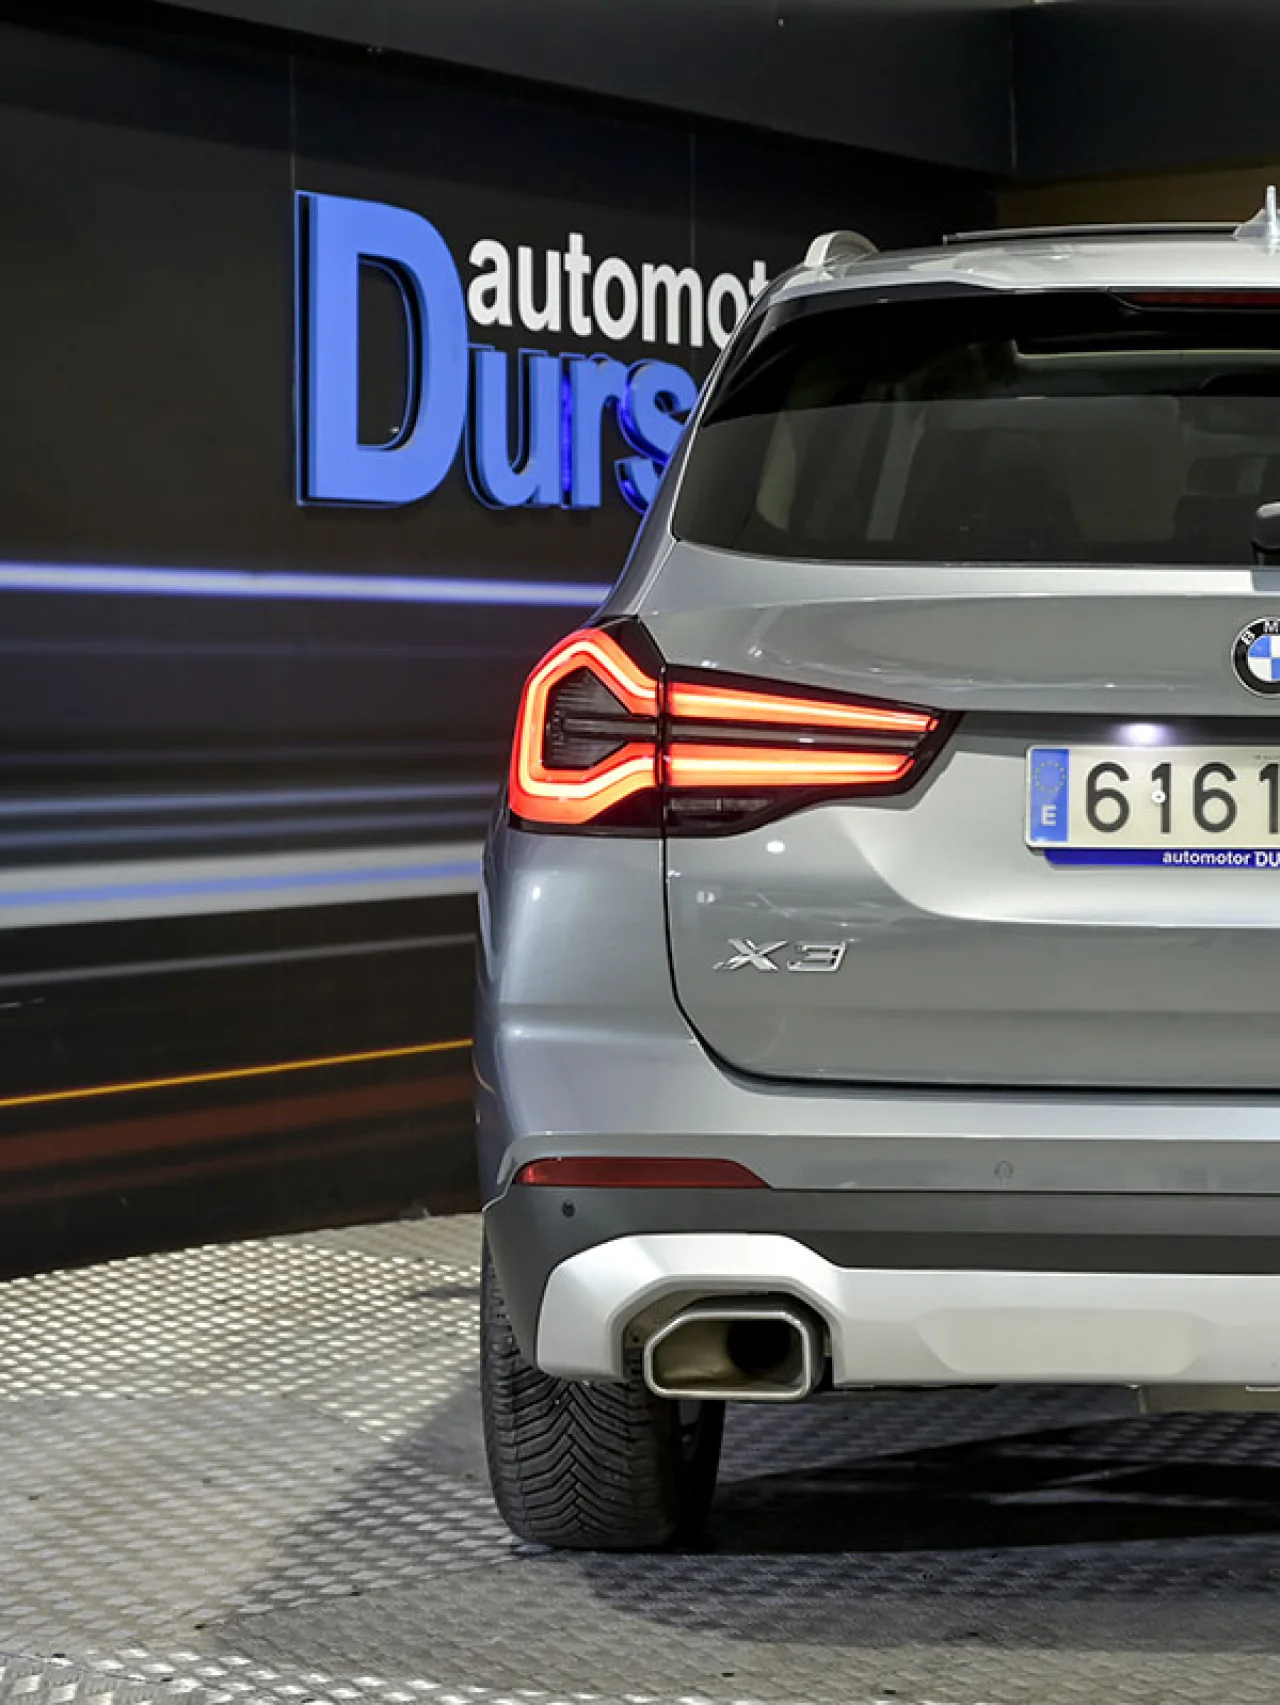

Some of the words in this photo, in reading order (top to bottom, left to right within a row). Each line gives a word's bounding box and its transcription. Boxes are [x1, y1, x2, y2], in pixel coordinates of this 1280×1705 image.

[1085, 761, 1280, 834] 6161
[1040, 804, 1058, 827] E
[1162, 851, 1251, 866] automotor
[713, 938, 847, 972] X3
